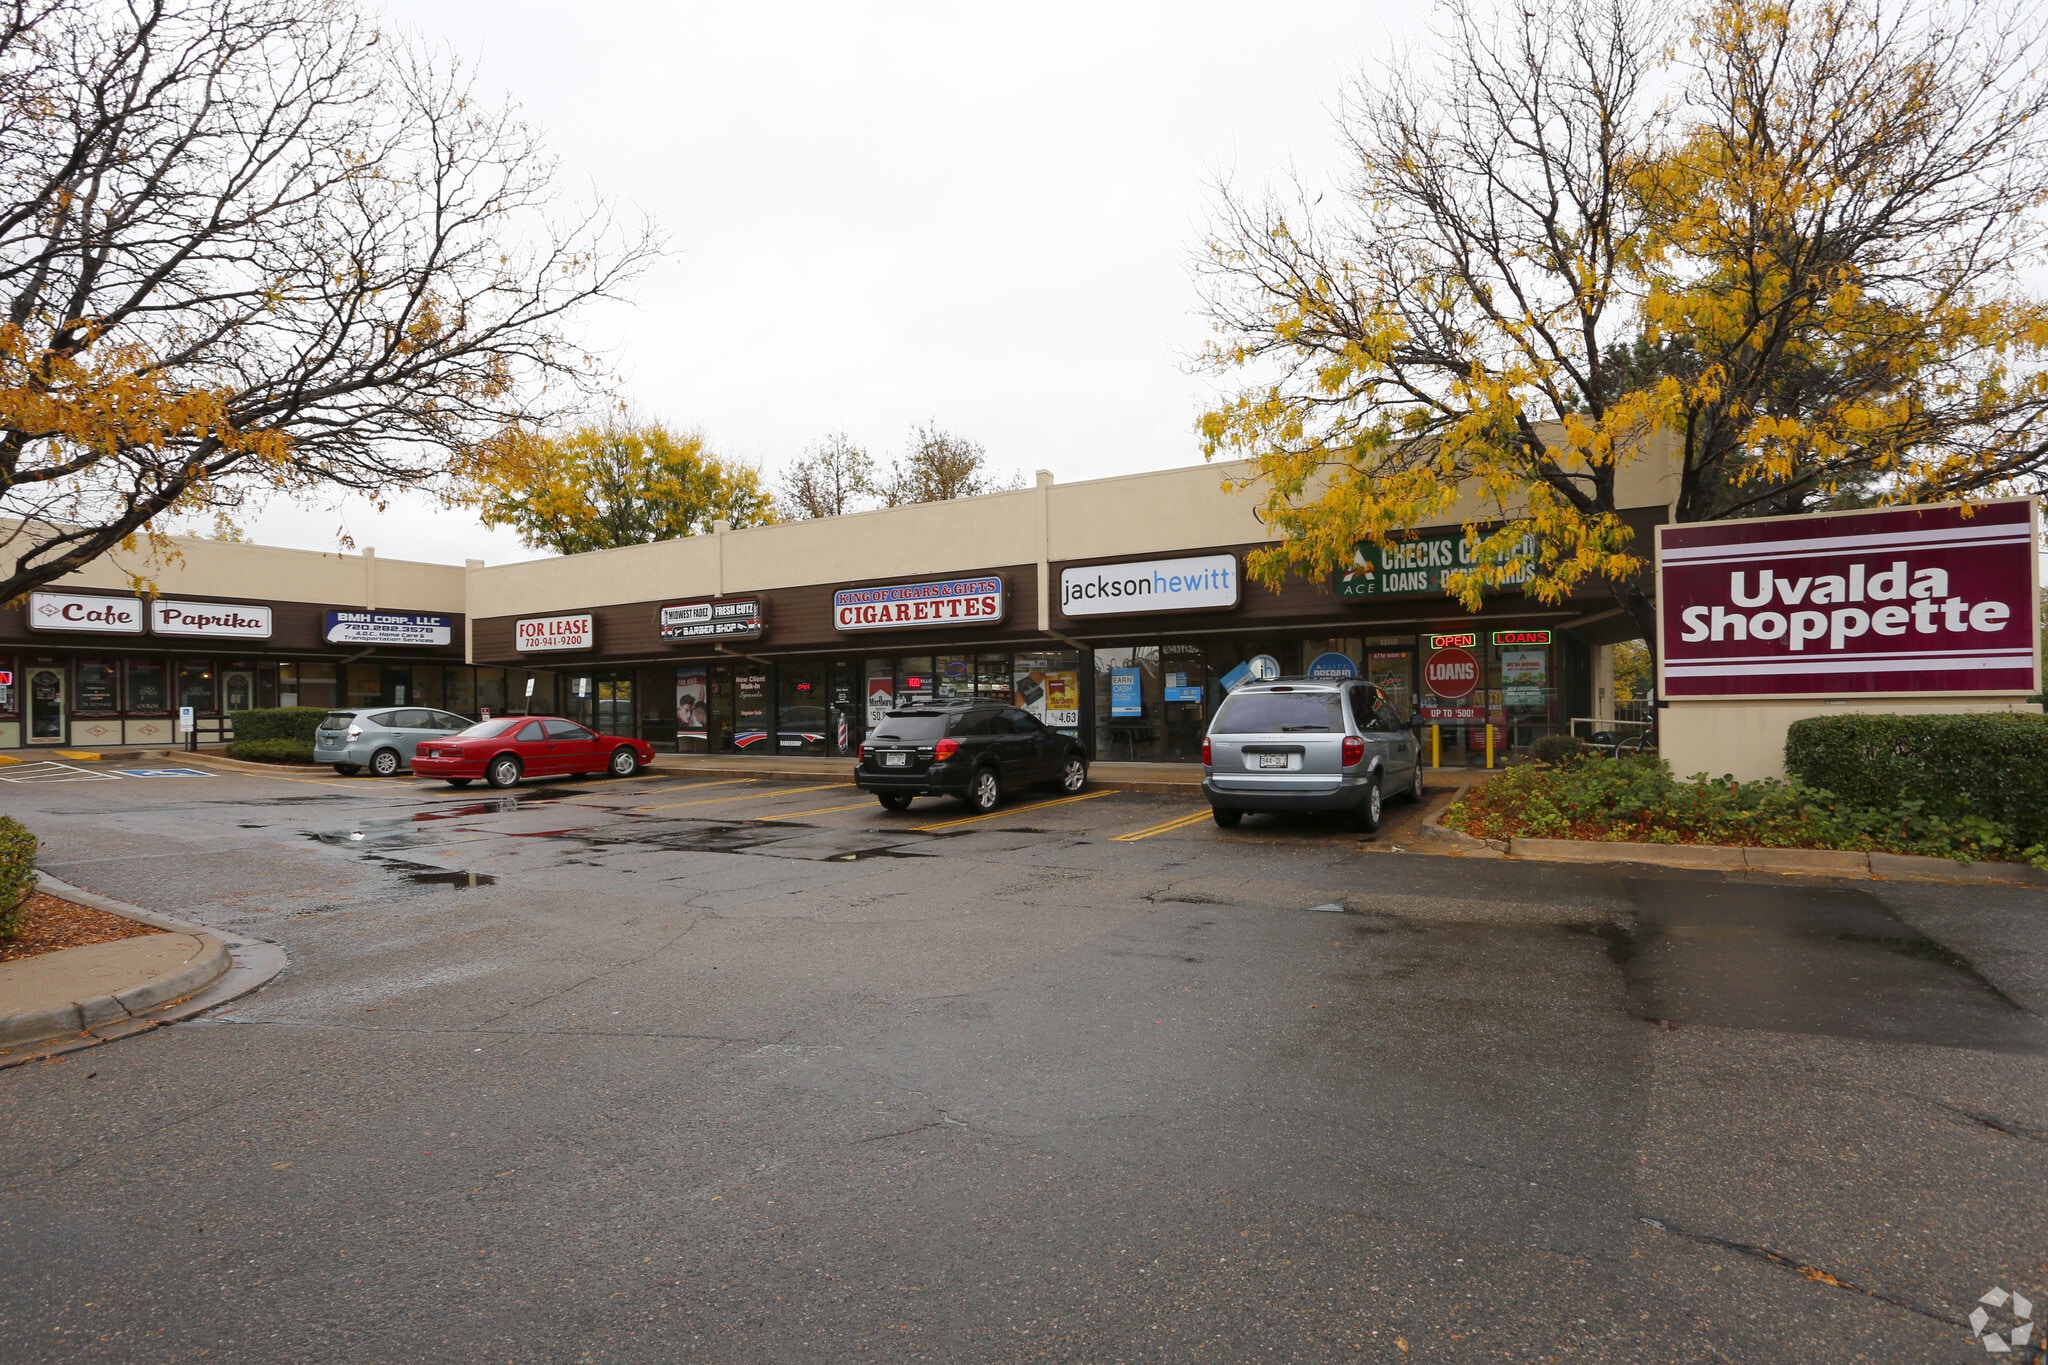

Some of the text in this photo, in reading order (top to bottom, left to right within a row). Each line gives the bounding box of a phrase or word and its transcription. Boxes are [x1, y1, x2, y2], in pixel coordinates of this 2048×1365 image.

[1382, 534, 1535, 570] CHECKS CED
[1486, 563, 1535, 586] CRDS
[1383, 571, 1428, 592] LOANS
[1731, 561, 1948, 608] Uvalda
[839, 581, 995, 604] KING OF CIGARS & GIFTS
[1344, 583, 1375, 595] ACE
[62, 603, 133, 625] Cafe
[669, 607, 708, 620] MIDWEST FADEZ
[715, 604, 753, 616] FRESH CUTZ
[839, 596, 996, 625] CIGARETTES
[159, 609, 262, 629] Paprika
[338, 613, 370, 623] BMH
[416, 617, 440, 626] LLC
[1681, 597, 2010, 651] Shoppette
[345, 624, 433, 633] 720.282.3578
[520, 619, 588, 637] FOR LEASE
[683, 623, 736, 636] BARBER SHOP
[525, 636, 582, 647] 720-941-9200
[1435, 635, 1472, 646] OPEN
[1496, 632, 1547, 644] LOANS
[1430, 663, 1474, 680] LOANS
[1113, 676, 1132, 684] EARN
[739, 691, 762, 699] Specials
[1113, 685, 1132, 693] CASH
[869, 696, 892, 707] Marlboro
[1051, 697, 1073, 705] Marlboro
[1059, 712, 1076, 723] 4.63
[1431, 709, 1441, 718] UP
[1443, 709, 1452, 717] TO
